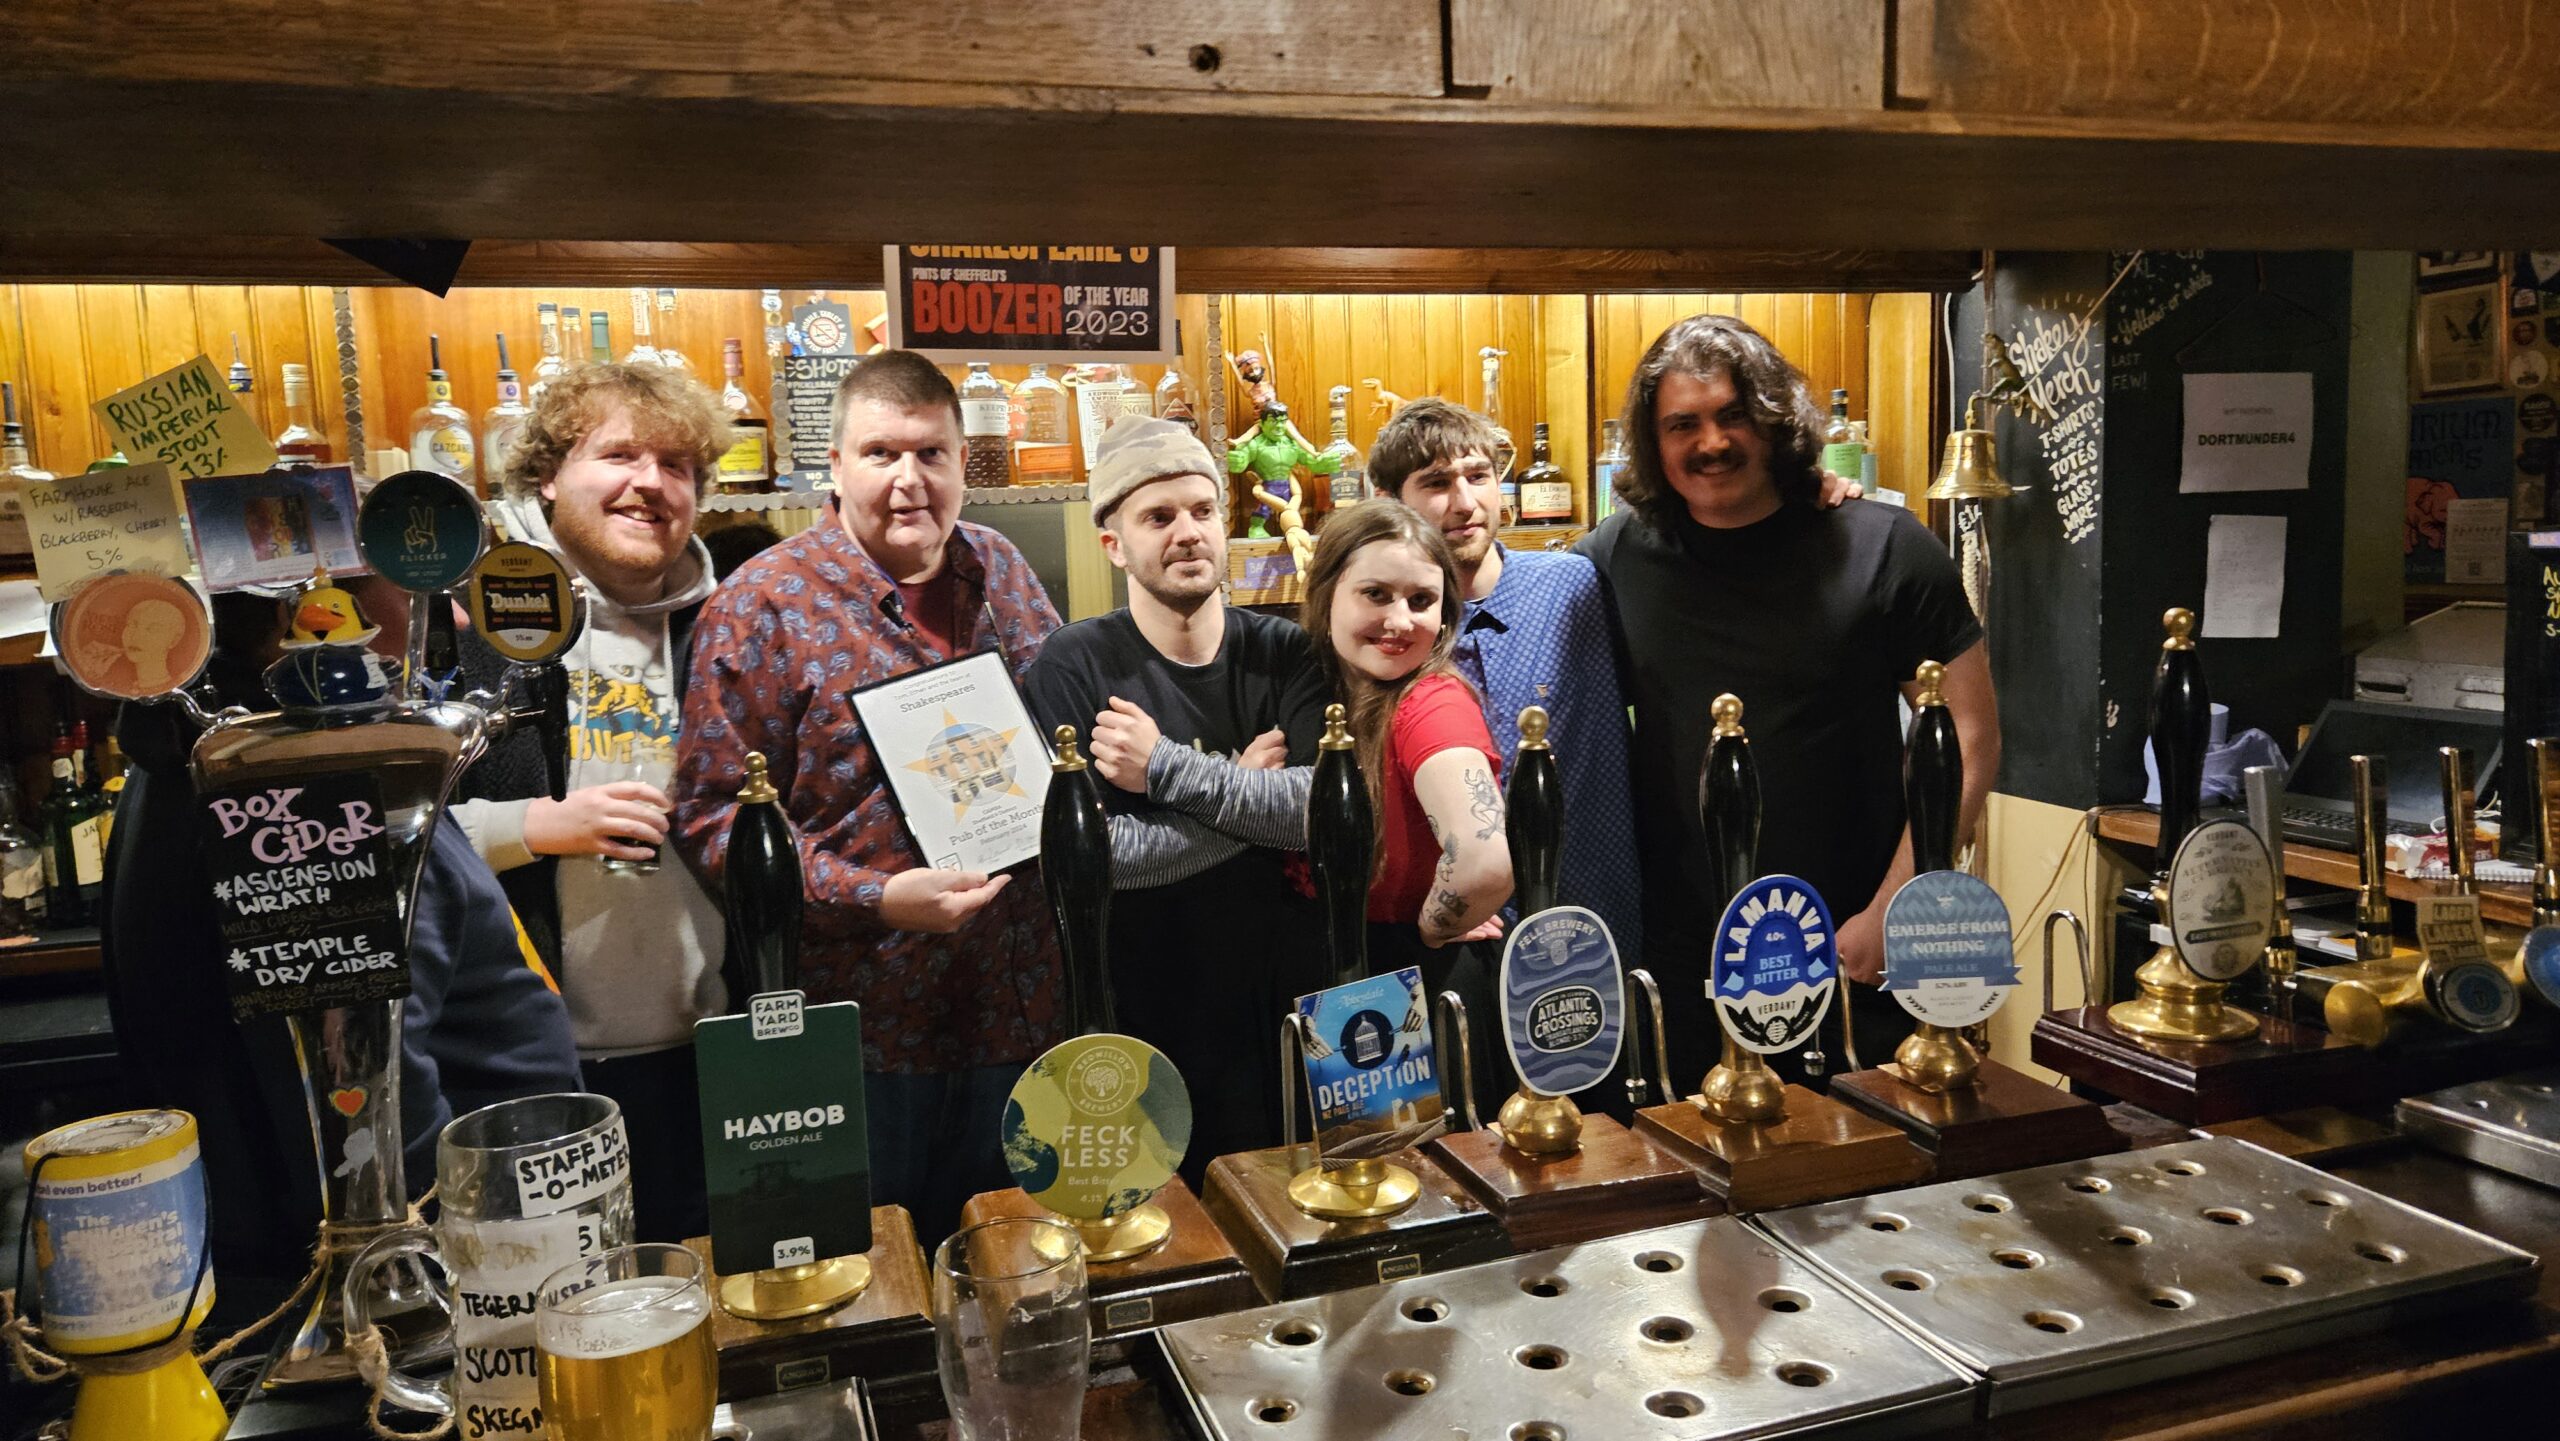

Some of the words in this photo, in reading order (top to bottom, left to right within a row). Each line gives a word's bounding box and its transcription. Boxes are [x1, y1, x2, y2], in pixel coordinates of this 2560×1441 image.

[912, 267, 938, 280] PINTS
[940, 268, 953, 281] OF
[954, 268, 1007, 282] SHEFFIELD'S
[912, 280, 1062, 336] BOOZER
[1063, 286, 1082, 306] OF
[1084, 286, 1110, 307] THE
[1113, 287, 1149, 307] YEAR
[1065, 309, 1149, 336] 2023
[107, 366, 212, 433] RUSSIAN
[131, 393, 231, 450] IMPERIAL
[2039, 401, 2096, 449] T-SHIRTS
[157, 420, 221, 465] STOUT
[2198, 432, 2296, 446] DORTMUNDER4
[2049, 440, 2099, 480] TOTES
[29, 484, 115, 510] FARMHOUSE
[125, 516, 168, 535] CHERRY
[2063, 501, 2098, 532] WARE
[86, 547, 124, 571] 5%
[487, 592, 553, 612] Dunkel
[900, 683, 976, 714] Shakespeares
[949, 831, 975, 847] Pub
[975, 824, 989, 838] of
[988, 818, 1009, 832] the
[235, 886, 332, 916] WRATH
[1518, 928, 1544, 951] FELL
[1543, 919, 1599, 938] BREWERY
[1724, 888, 1826, 963] LAMANVA
[1888, 922, 1958, 938] EMERGE
[1960, 920, 2009, 934] FROM
[1912, 939, 1986, 955] NOTHING
[254, 960, 315, 987] DRY
[324, 950, 400, 976] CIDER
[1759, 954, 1793, 971] BEST
[1753, 967, 1800, 986] BITTER
[755, 998, 799, 1014] FARM
[1538, 997, 1593, 1023] ATLANTIC
[1757, 1000, 1797, 1016] VERDANT
[756, 1012, 800, 1027] YARD
[1534, 1011, 1599, 1038] CROSSINGS
[1318, 1055, 1431, 1111] DECEPTION
[724, 1104, 847, 1141] HAYBOB
[1061, 1125, 1136, 1146] FECK
[749, 1134, 800, 1152] GOLDEN
[801, 1131, 824, 1145] ALE
[519, 1142, 597, 1185] STAFF
[1062, 1148, 1130, 1169] LESS
[53, 1182, 85, 1197] even
[87, 1172, 143, 1195] better!
[777, 1244, 811, 1260] 3.9%
